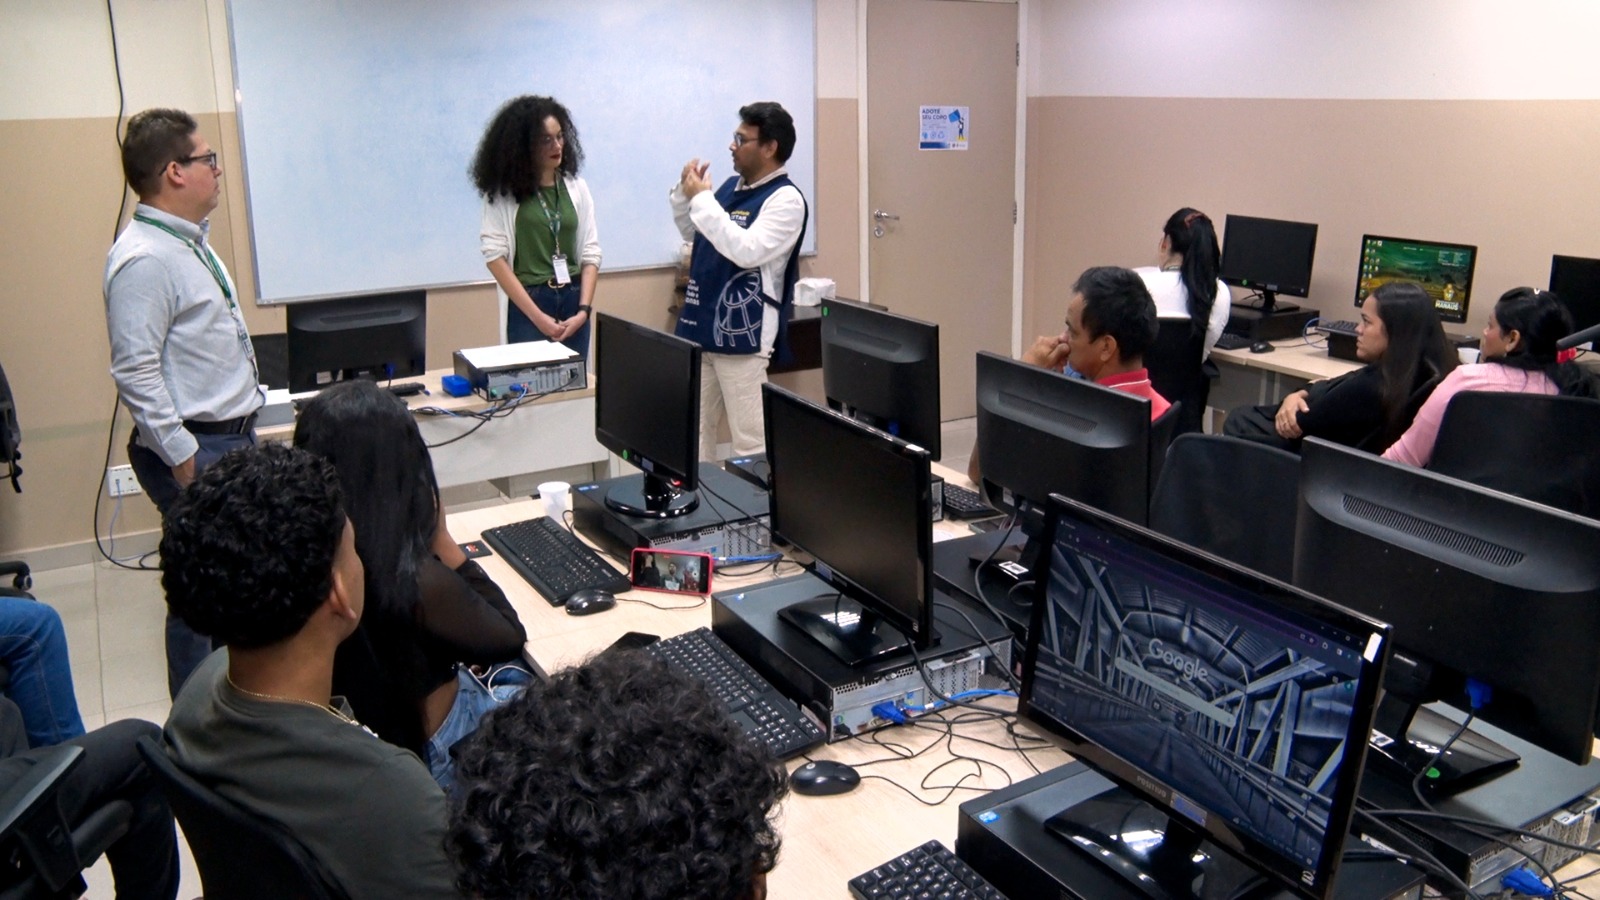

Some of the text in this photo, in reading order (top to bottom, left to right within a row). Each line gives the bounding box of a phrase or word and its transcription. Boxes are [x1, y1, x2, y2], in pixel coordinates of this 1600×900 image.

[1435, 301, 1459, 311] MANAUS
[1149, 638, 1208, 682] Google
[1136, 775, 1167, 798] POSITIVO
